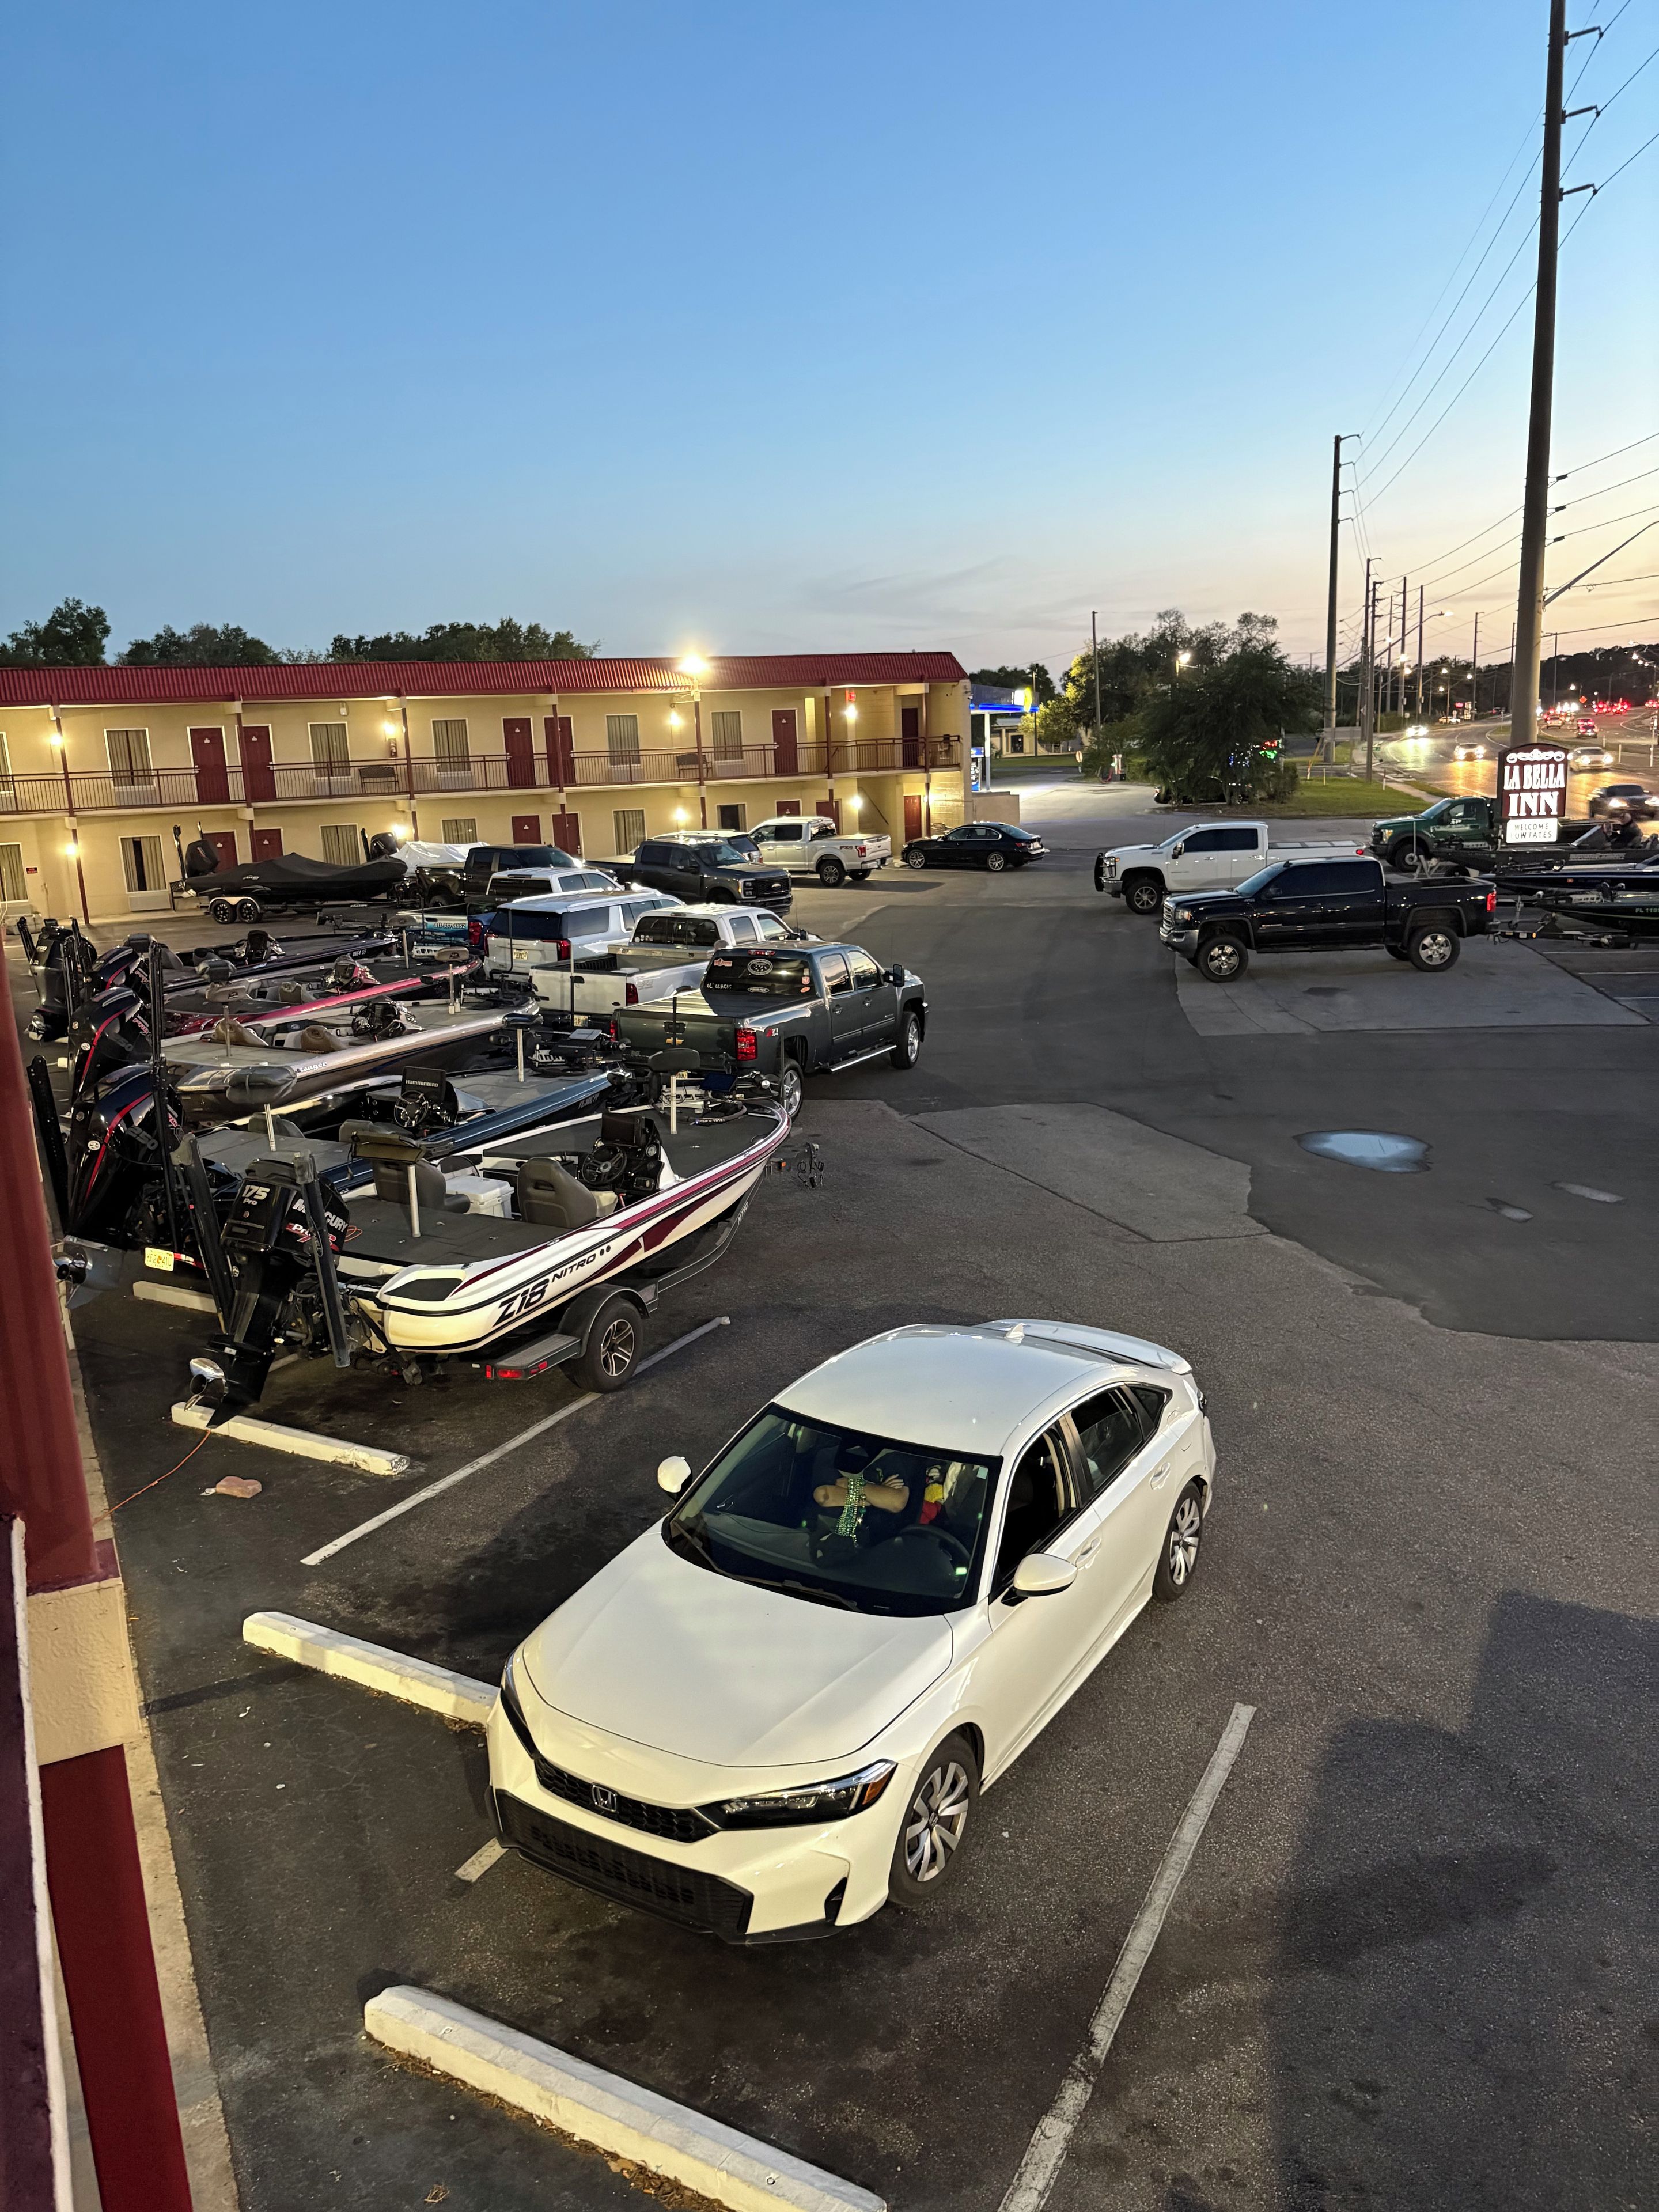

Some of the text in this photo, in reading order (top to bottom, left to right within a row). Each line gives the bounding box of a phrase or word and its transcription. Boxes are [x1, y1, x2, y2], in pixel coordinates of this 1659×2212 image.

[1503, 763, 1566, 790] LA BELLA
[1508, 791, 1559, 816] INN
[1514, 823, 1549, 831] WELCOME
[127, 1125, 158, 1150] 250
[241, 1184, 270, 1200] 175
[292, 1198, 349, 1233] MCURY
[491, 1253, 597, 1328] Z18 NITRO
